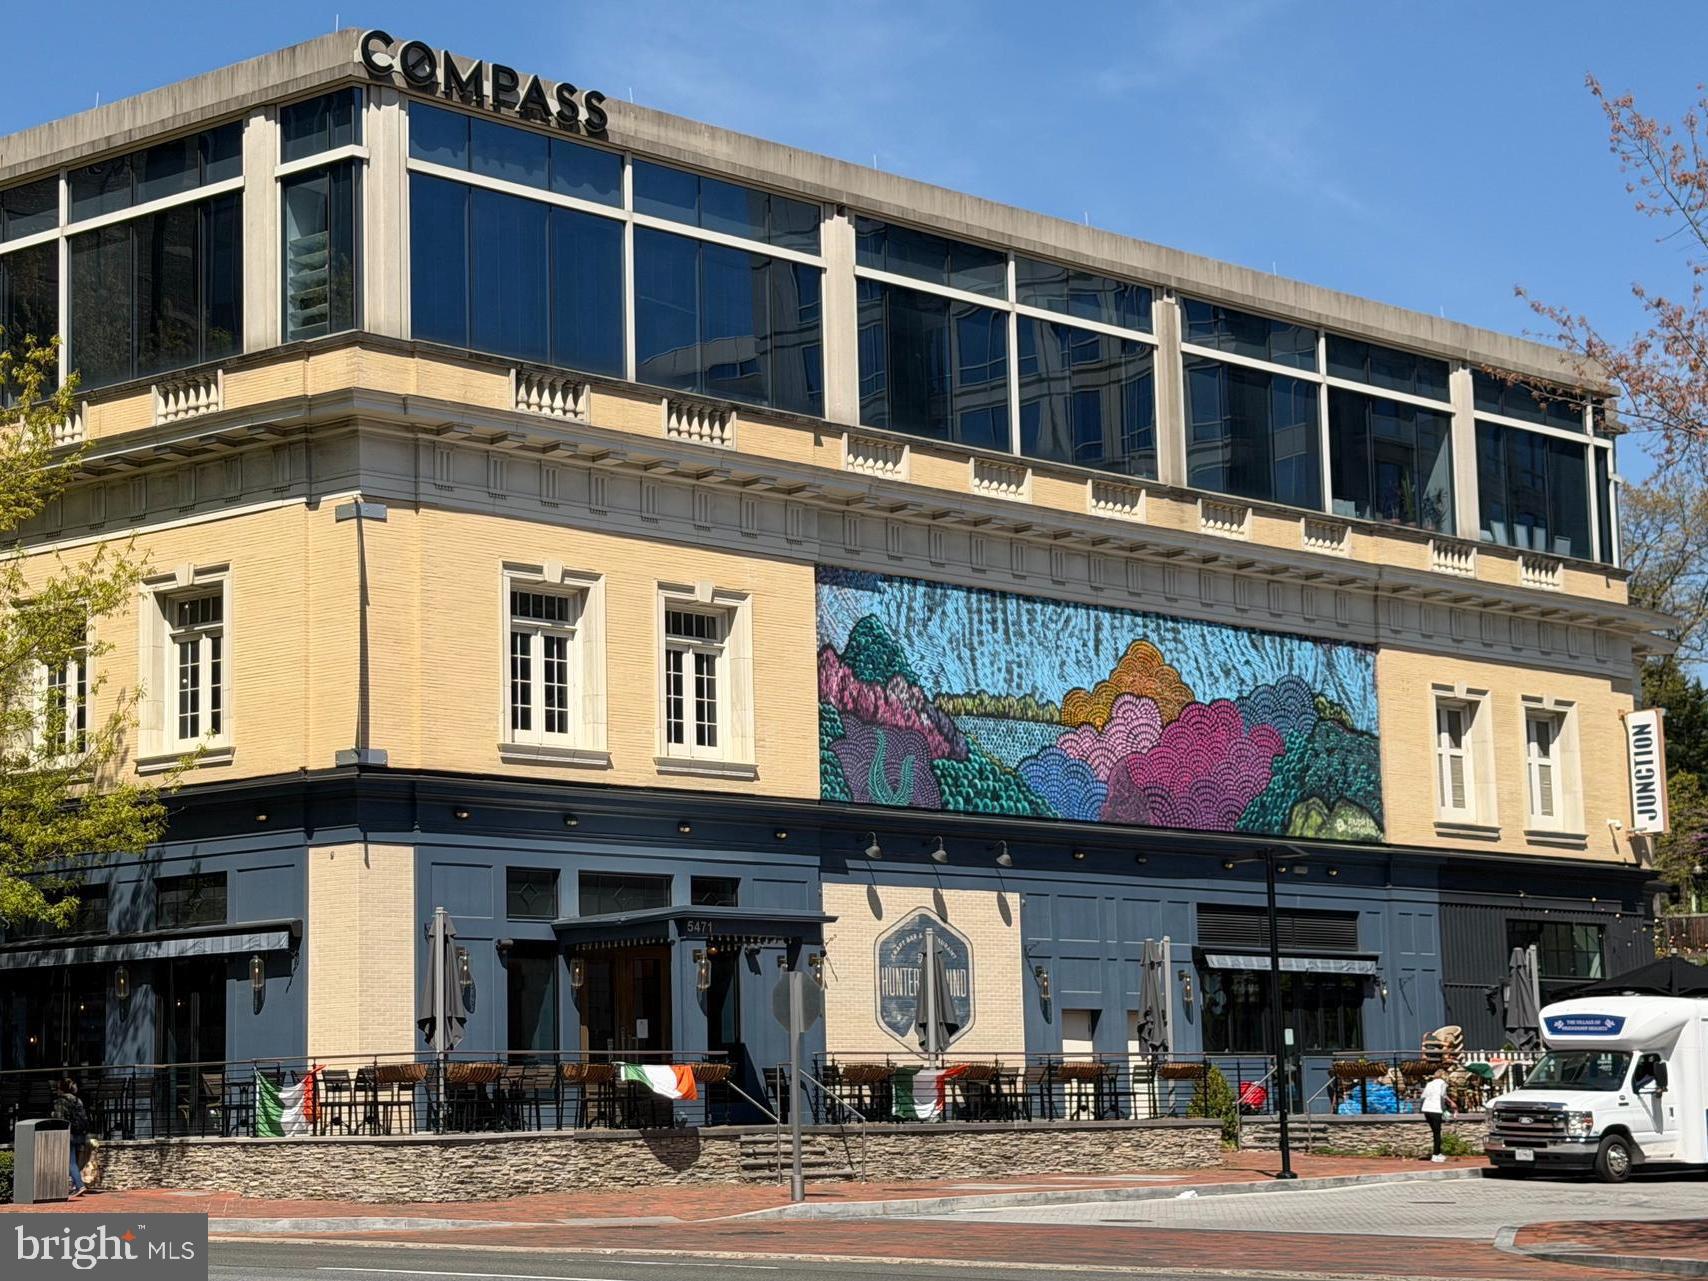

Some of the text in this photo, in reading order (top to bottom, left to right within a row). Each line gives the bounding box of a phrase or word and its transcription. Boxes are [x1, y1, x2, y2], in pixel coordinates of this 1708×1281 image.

[358, 29, 608, 133] COMPASS
[1632, 723, 1658, 821] JUNCTION
[687, 920, 712, 932] 5471
